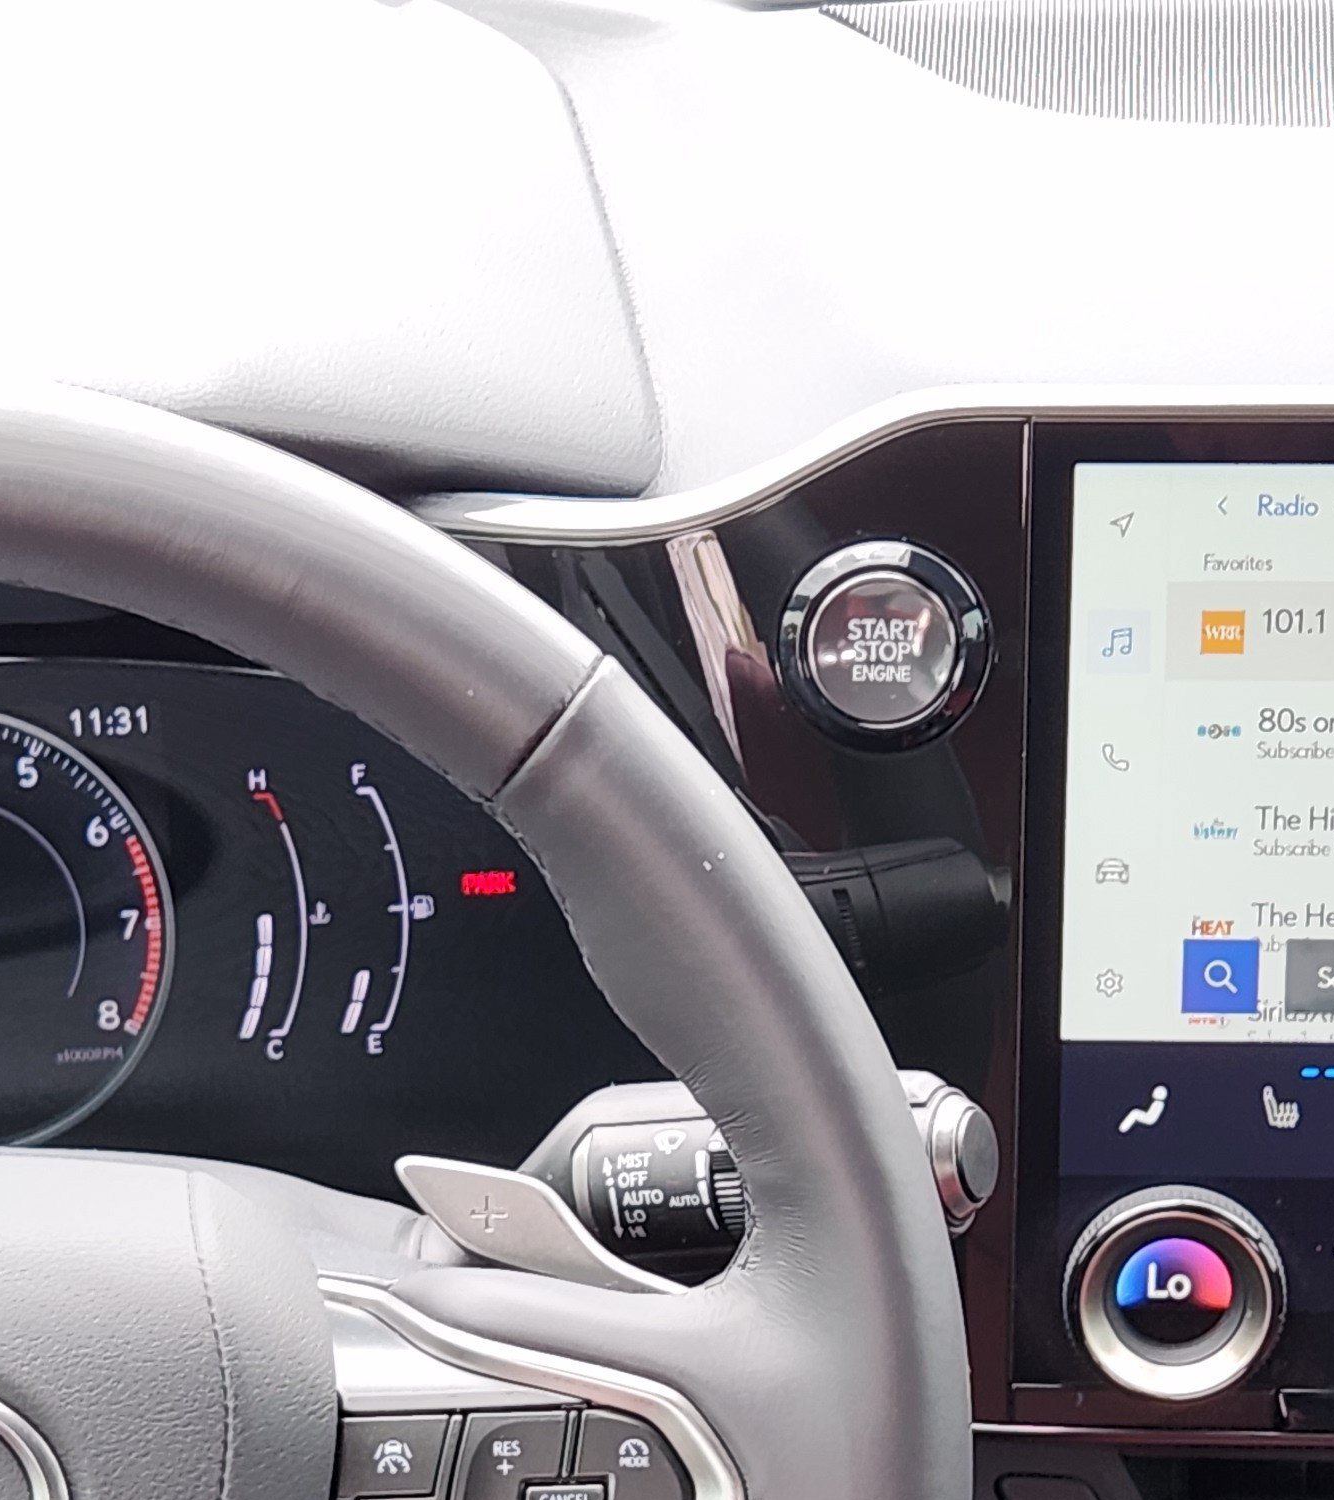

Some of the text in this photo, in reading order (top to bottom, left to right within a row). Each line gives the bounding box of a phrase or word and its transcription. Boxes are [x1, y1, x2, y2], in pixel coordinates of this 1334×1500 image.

[1257, 494, 1319, 518] Radio
[1203, 553, 1273, 573] Favorites
[847, 618, 917, 640] START
[1262, 608, 1326, 634] 101.1
[853, 641, 912, 663] STOP
[851, 664, 912, 683] ENGINE
[69, 705, 149, 737] 11:31
[1259, 708, 1307, 734] 80s
[17, 756, 40, 788] 5
[248, 769, 267, 791] H
[351, 764, 365, 785] F
[1254, 805, 1302, 831] The
[86, 815, 110, 847] 6
[1252, 839, 1332, 858] Subscribe
[120, 910, 139, 940] 7
[1251, 902, 1298, 928] The
[97, 999, 120, 1030] 8
[267, 1040, 283, 1061] C
[367, 1034, 383, 1055] E
[617, 1152, 652, 1169] MIST
[617, 1170, 648, 1188] OFF
[622, 1188, 664, 1206] AUTO
[669, 1193, 700, 1208] AUTO
[624, 1209, 647, 1224] LO
[1147, 1261, 1193, 1300] Lo
[492, 1440, 522, 1457] RES
